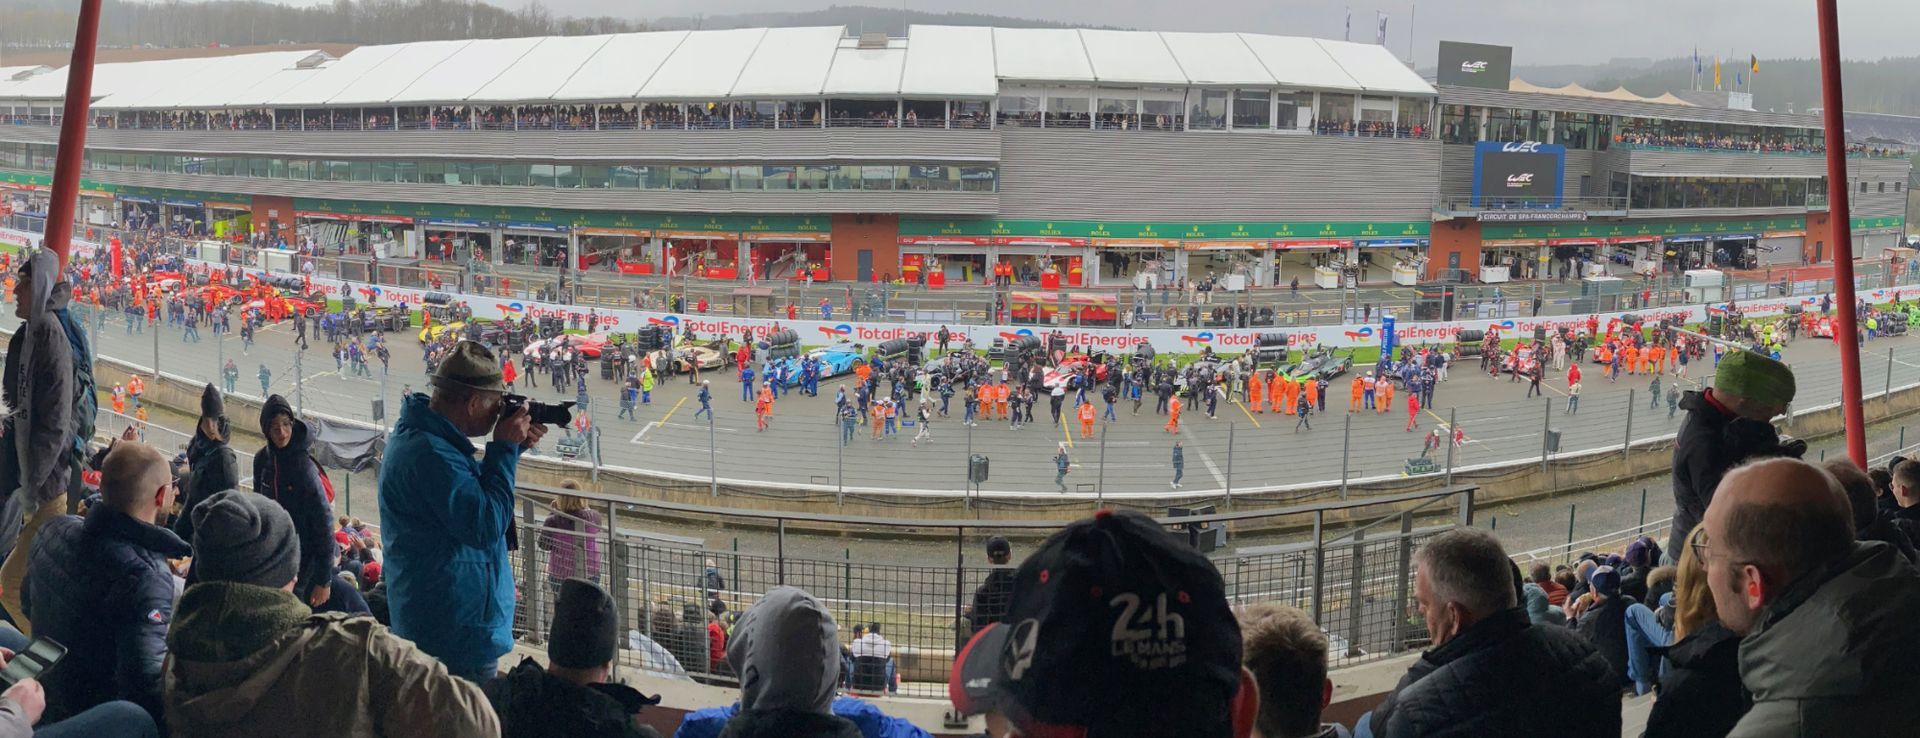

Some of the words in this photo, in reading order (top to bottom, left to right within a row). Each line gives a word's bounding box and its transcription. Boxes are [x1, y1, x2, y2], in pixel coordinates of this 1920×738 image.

[1462, 61, 1488, 69] WEC
[1502, 141, 1542, 153] WEC
[1507, 173, 1534, 182] WEC
[1109, 592, 1185, 641] 24h
[1111, 640, 1134, 657] LE
[1136, 640, 1186, 656] MANS
